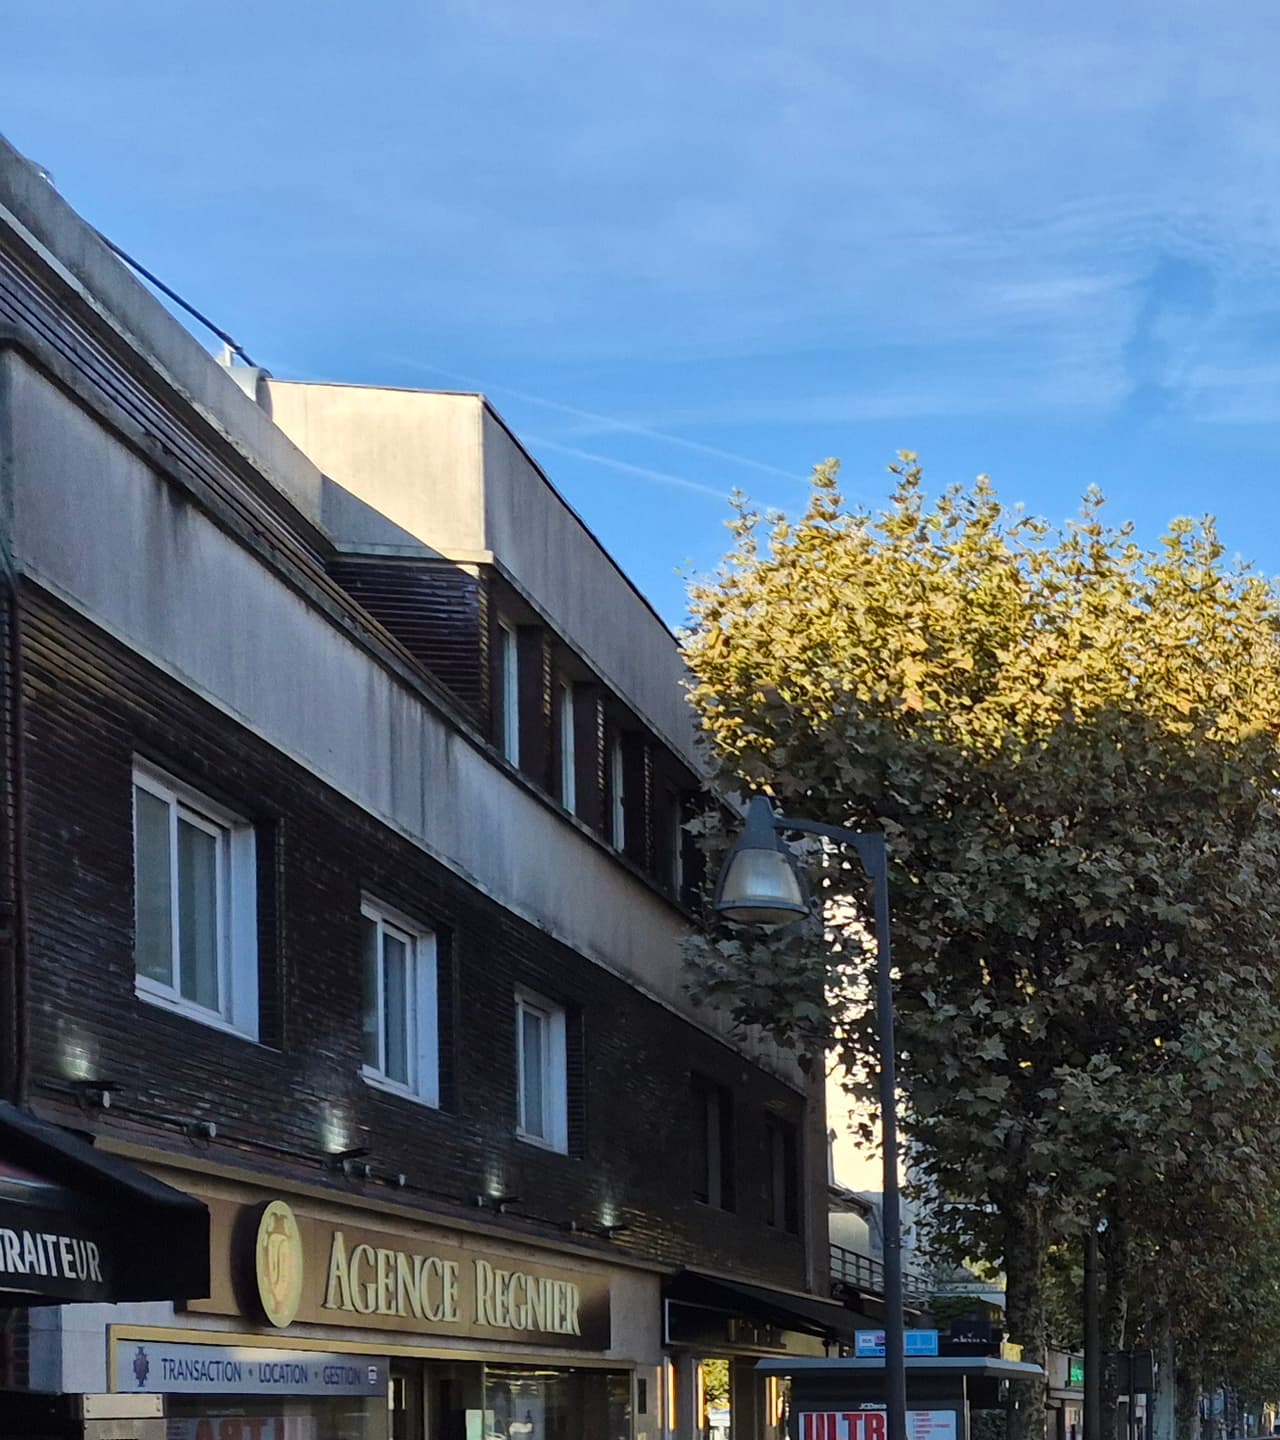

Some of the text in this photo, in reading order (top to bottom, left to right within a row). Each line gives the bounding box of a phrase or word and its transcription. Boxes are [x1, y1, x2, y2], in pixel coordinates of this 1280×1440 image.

[323, 1231, 582, 1337] AGENCE REGNIER
[161, 1358, 361, 1385] TRANSACTION LOCATION GESTION
